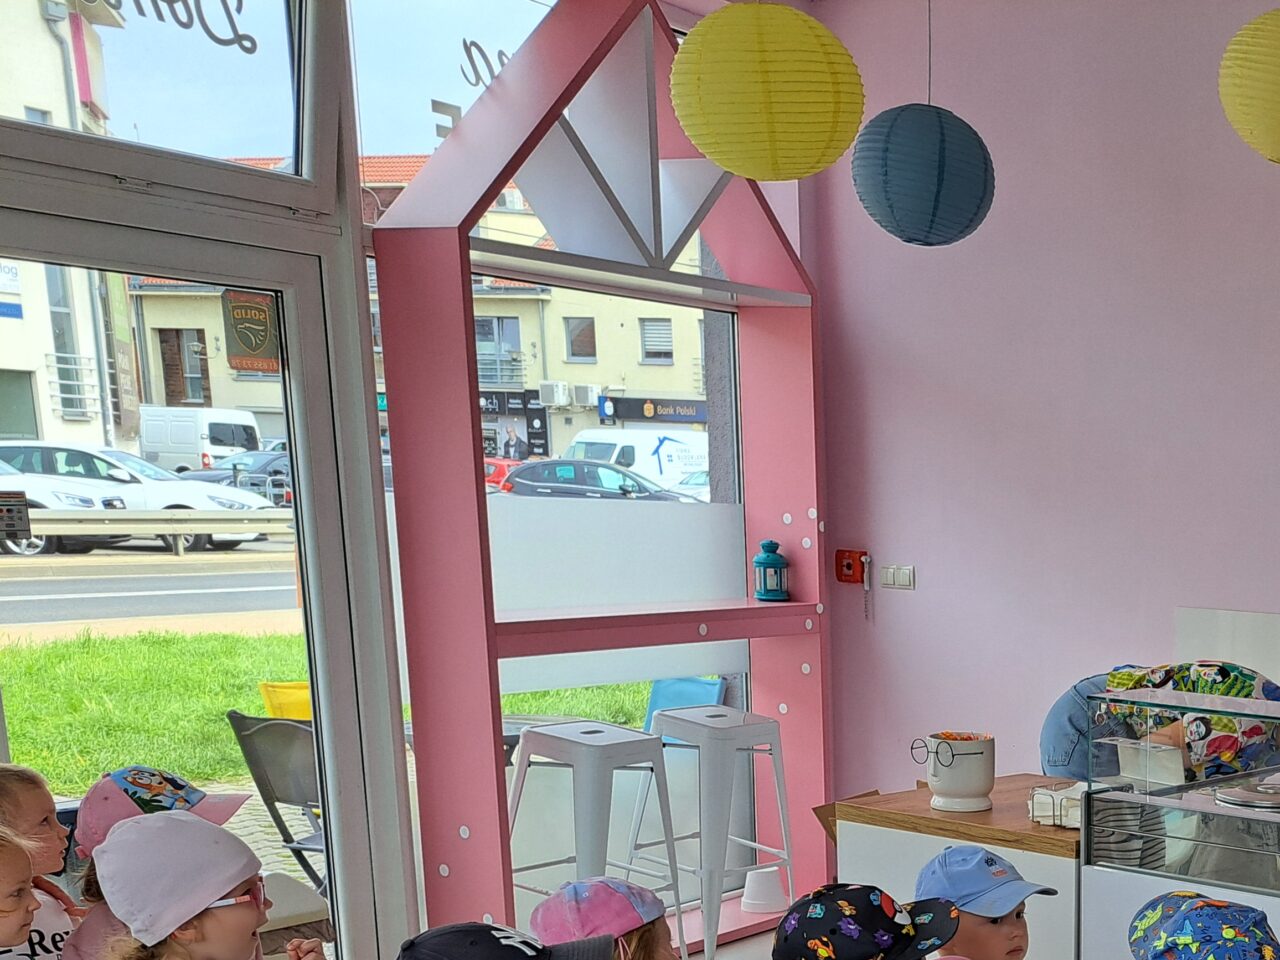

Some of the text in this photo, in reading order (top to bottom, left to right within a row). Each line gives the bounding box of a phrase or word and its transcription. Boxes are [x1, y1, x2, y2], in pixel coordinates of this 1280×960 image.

[657, 405, 696, 416] Bank Polski
[28, 929, 76, 956] Re
